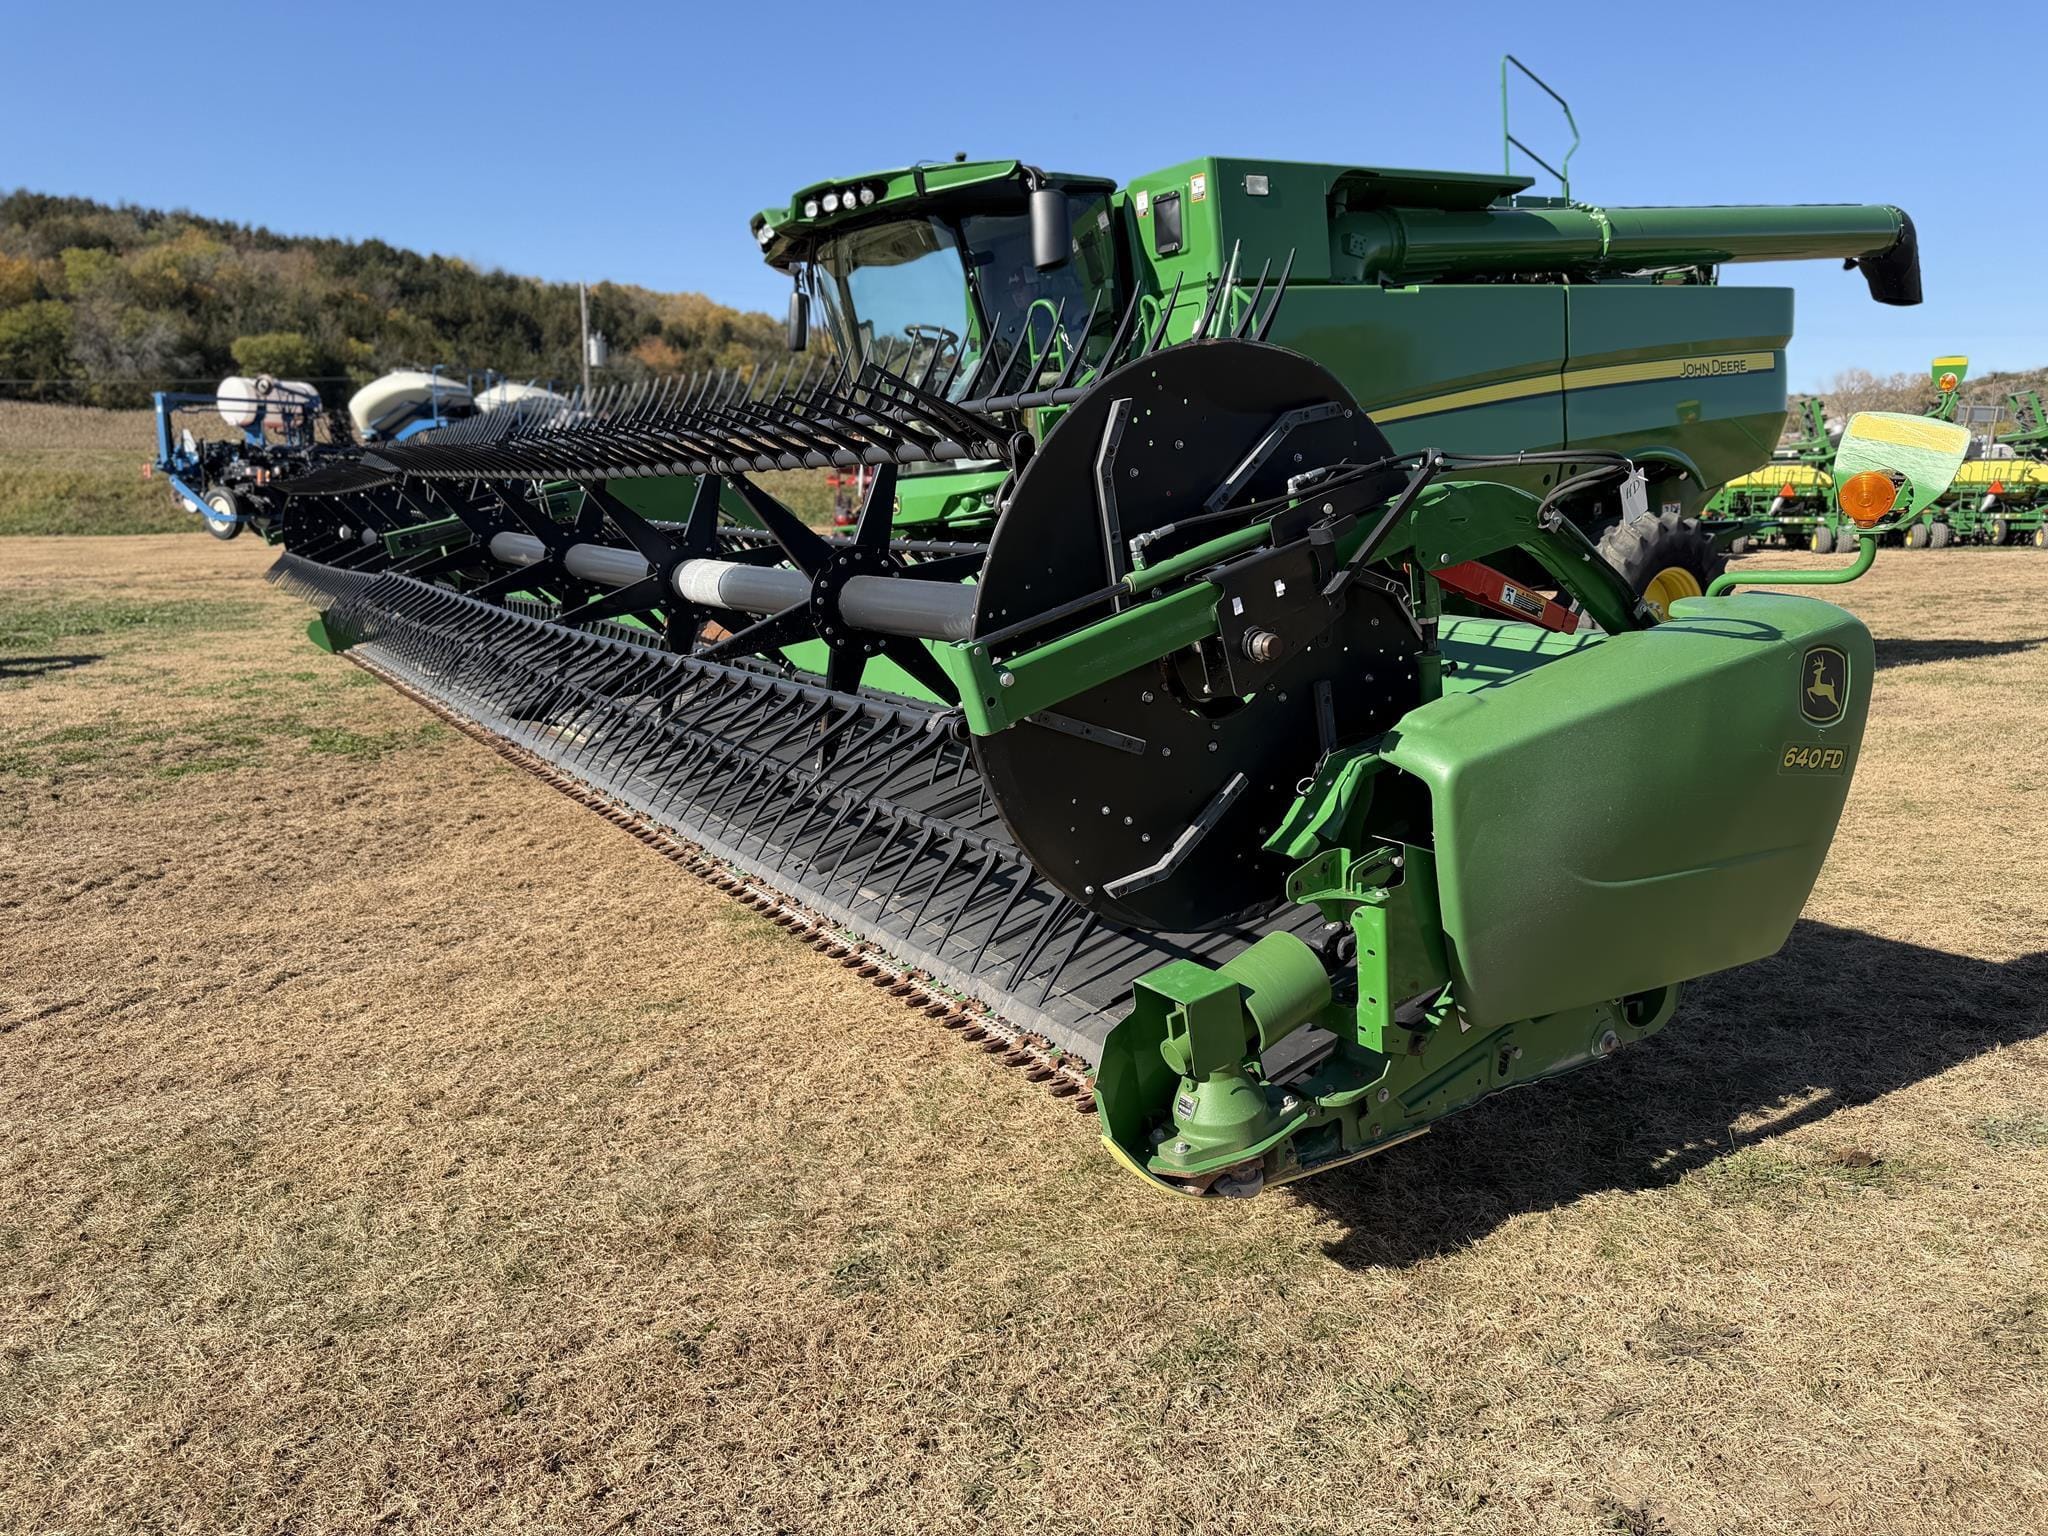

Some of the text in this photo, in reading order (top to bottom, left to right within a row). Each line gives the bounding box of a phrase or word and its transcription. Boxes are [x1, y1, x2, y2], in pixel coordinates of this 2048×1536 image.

[1680, 360, 1747, 377] JOHN DEERE
[1783, 747, 1844, 769] 640FD
